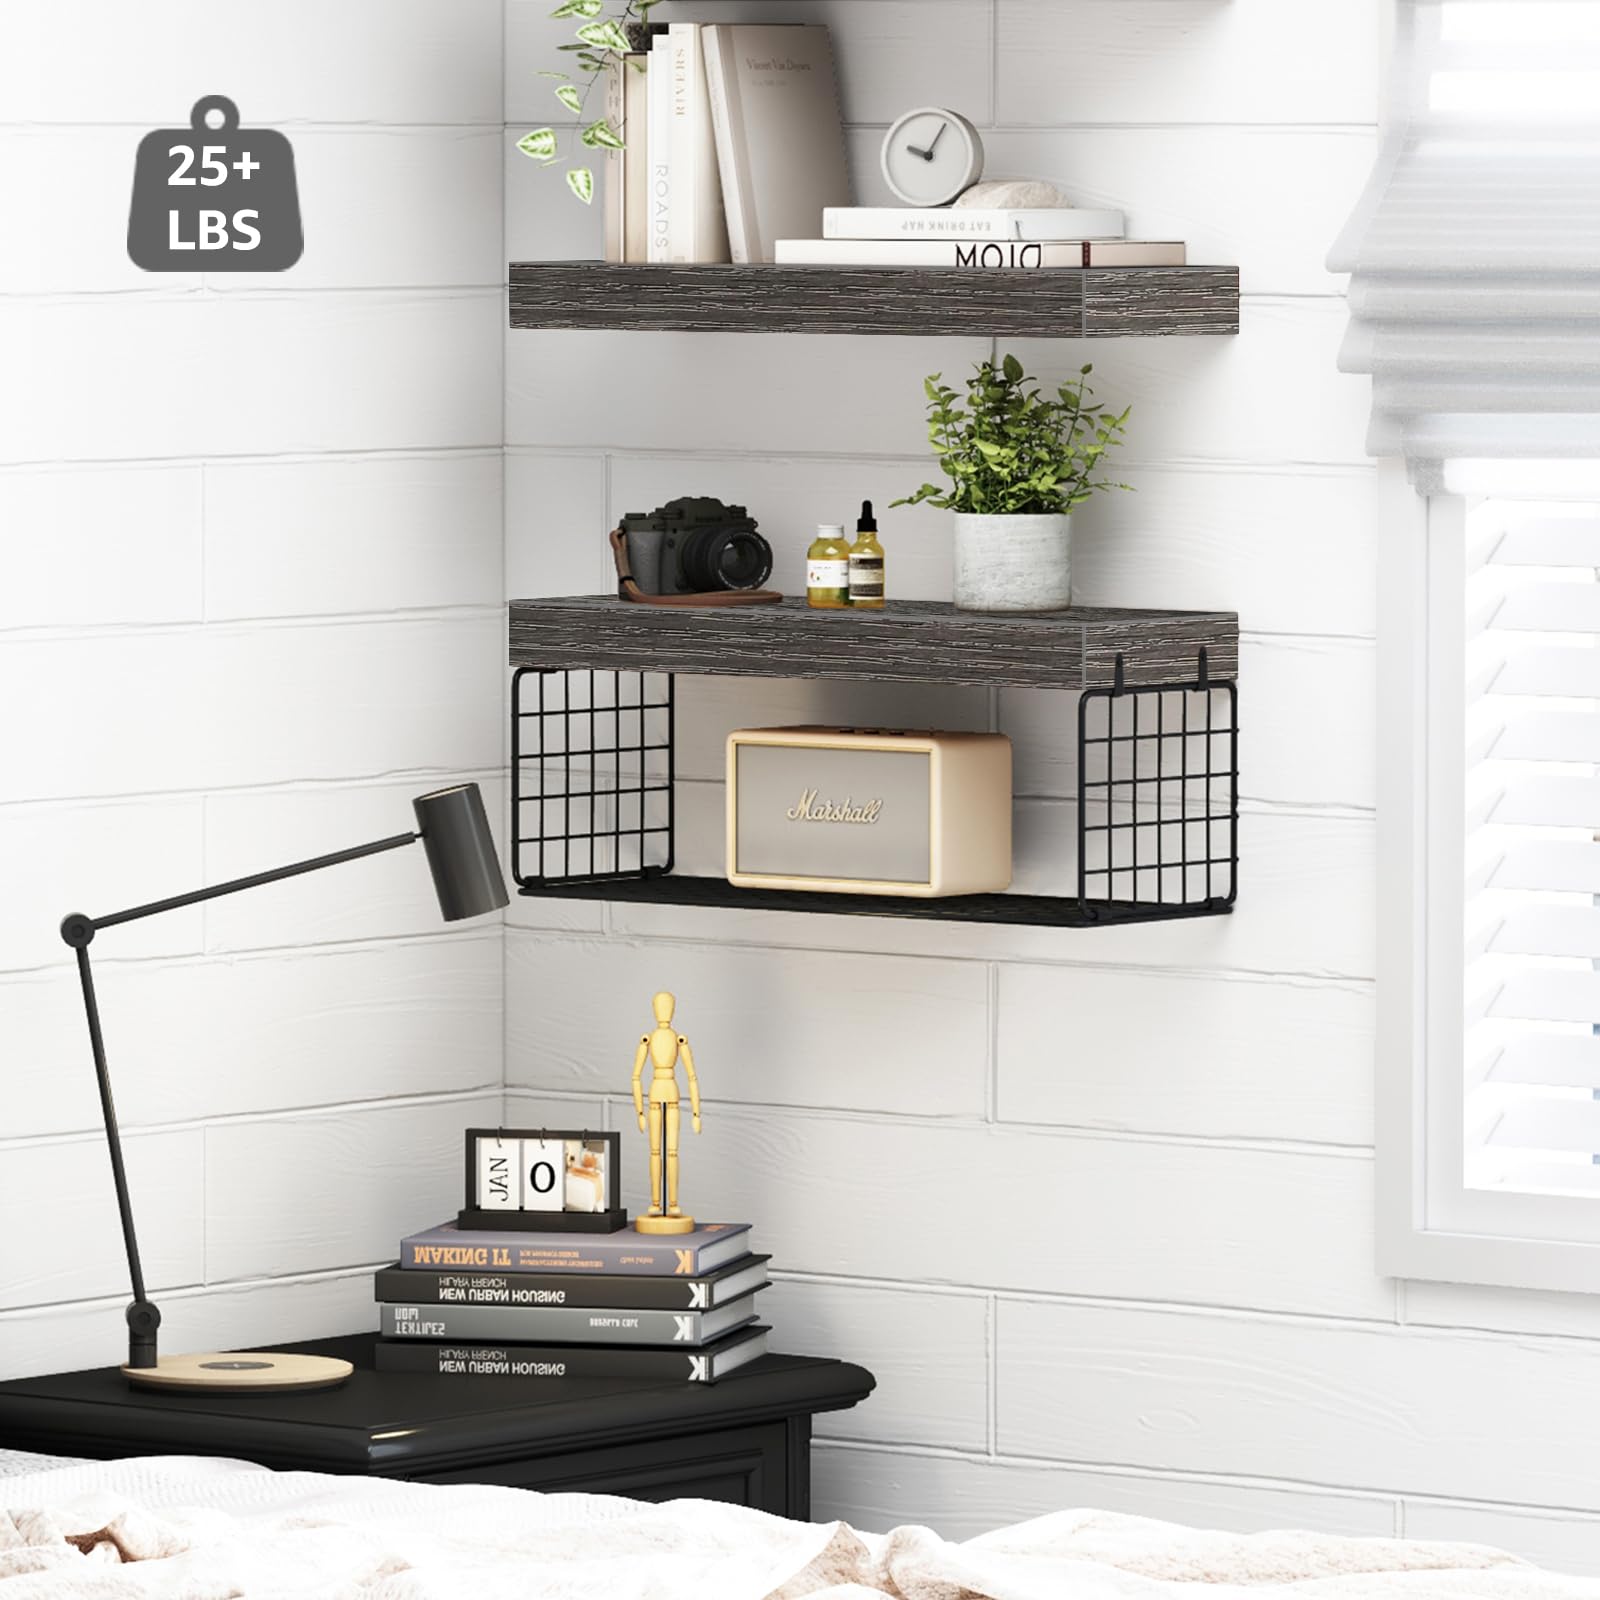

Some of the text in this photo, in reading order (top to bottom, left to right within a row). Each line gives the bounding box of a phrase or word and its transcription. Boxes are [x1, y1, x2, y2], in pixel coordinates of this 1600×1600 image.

[655, 163, 670, 249] ROADS
[786, 787, 883, 824] Marshall
[488, 1157, 509, 1202] JAN
